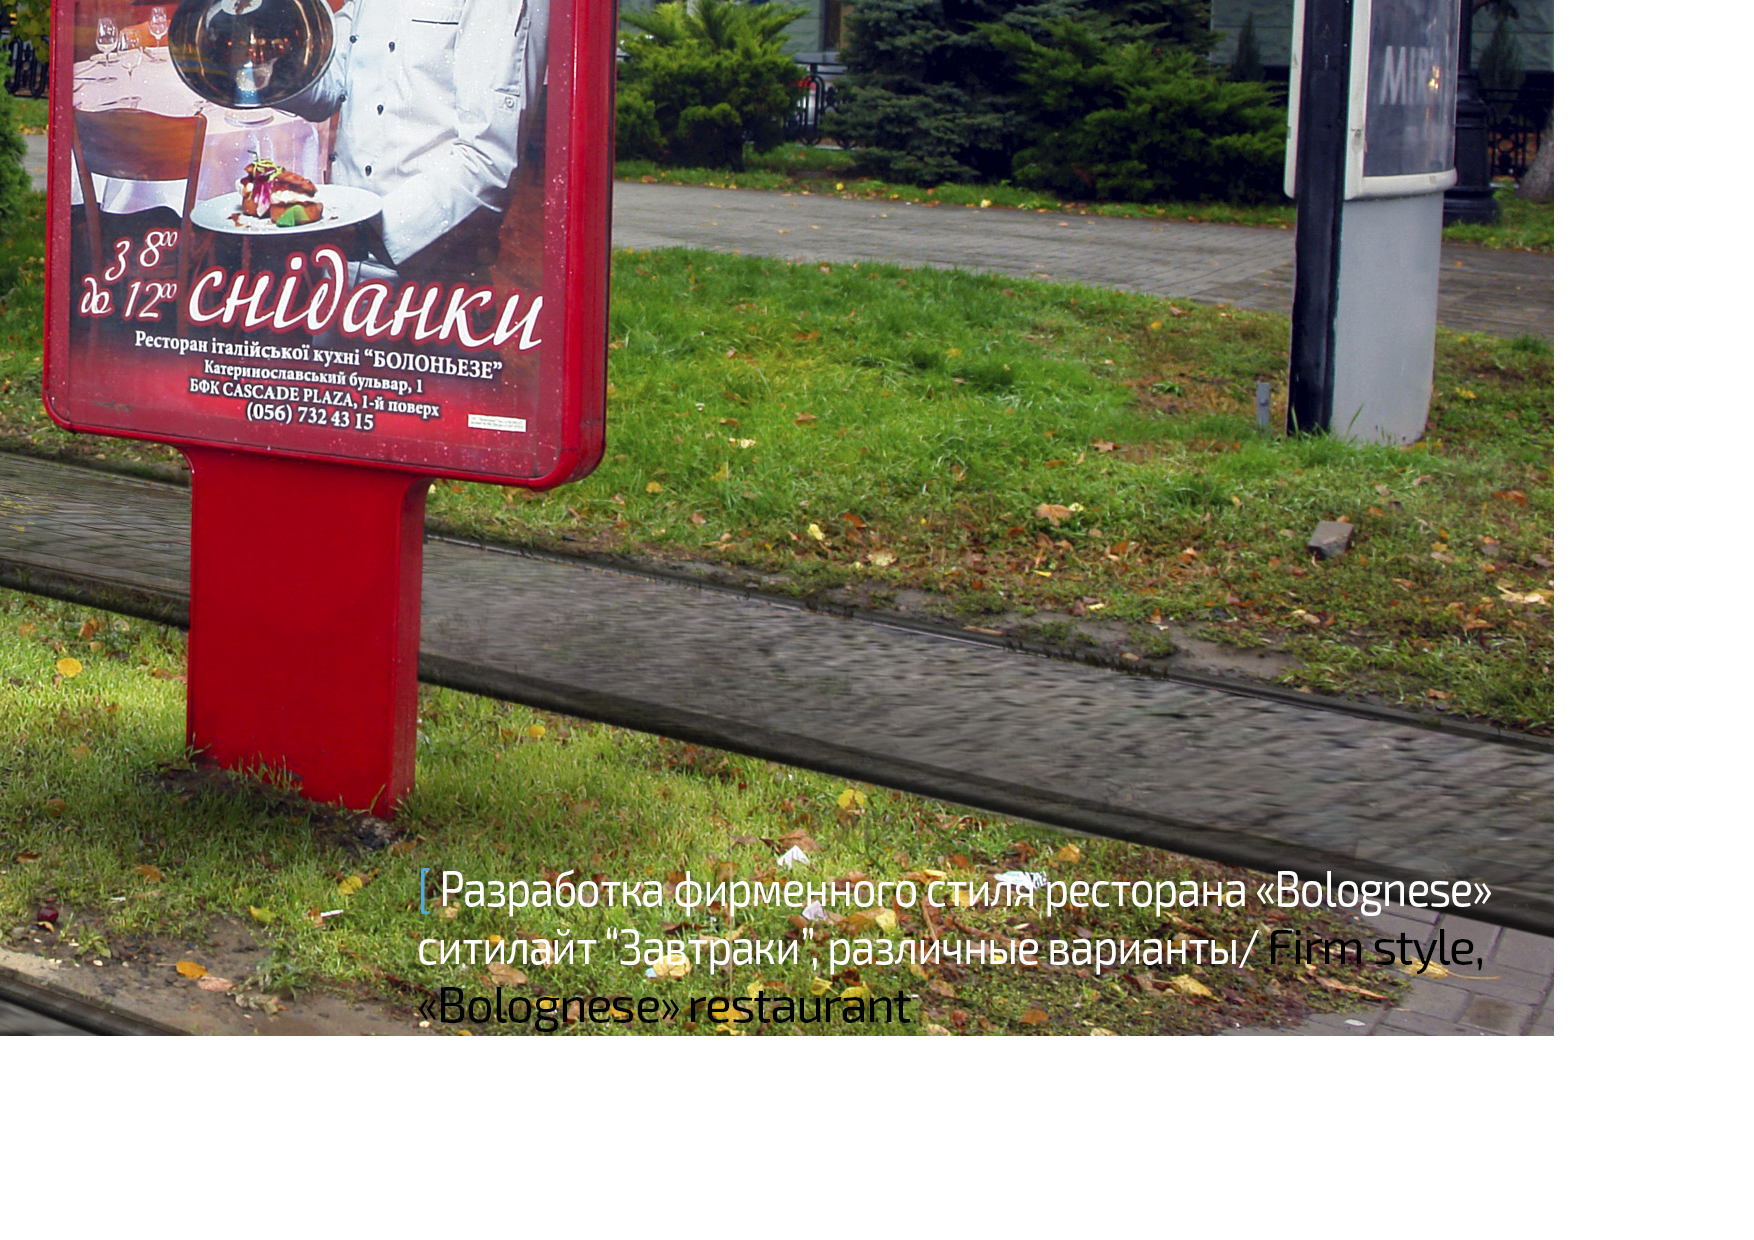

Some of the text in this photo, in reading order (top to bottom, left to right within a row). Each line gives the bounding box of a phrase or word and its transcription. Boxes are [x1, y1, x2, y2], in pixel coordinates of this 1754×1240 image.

[80, 277, 112, 314] до
[189, 249, 543, 351] сніданки
[135, 330, 503, 380] Ресторан італійської кухні “БОЛОНЬЕЗЕ”
[204, 360, 423, 395] Катеринославський бульвар, 1
[189, 378, 440, 418] БФК CASCADE PLAZA, 1-й поверх
[246, 401, 375, 431] (056) 732 43 15
